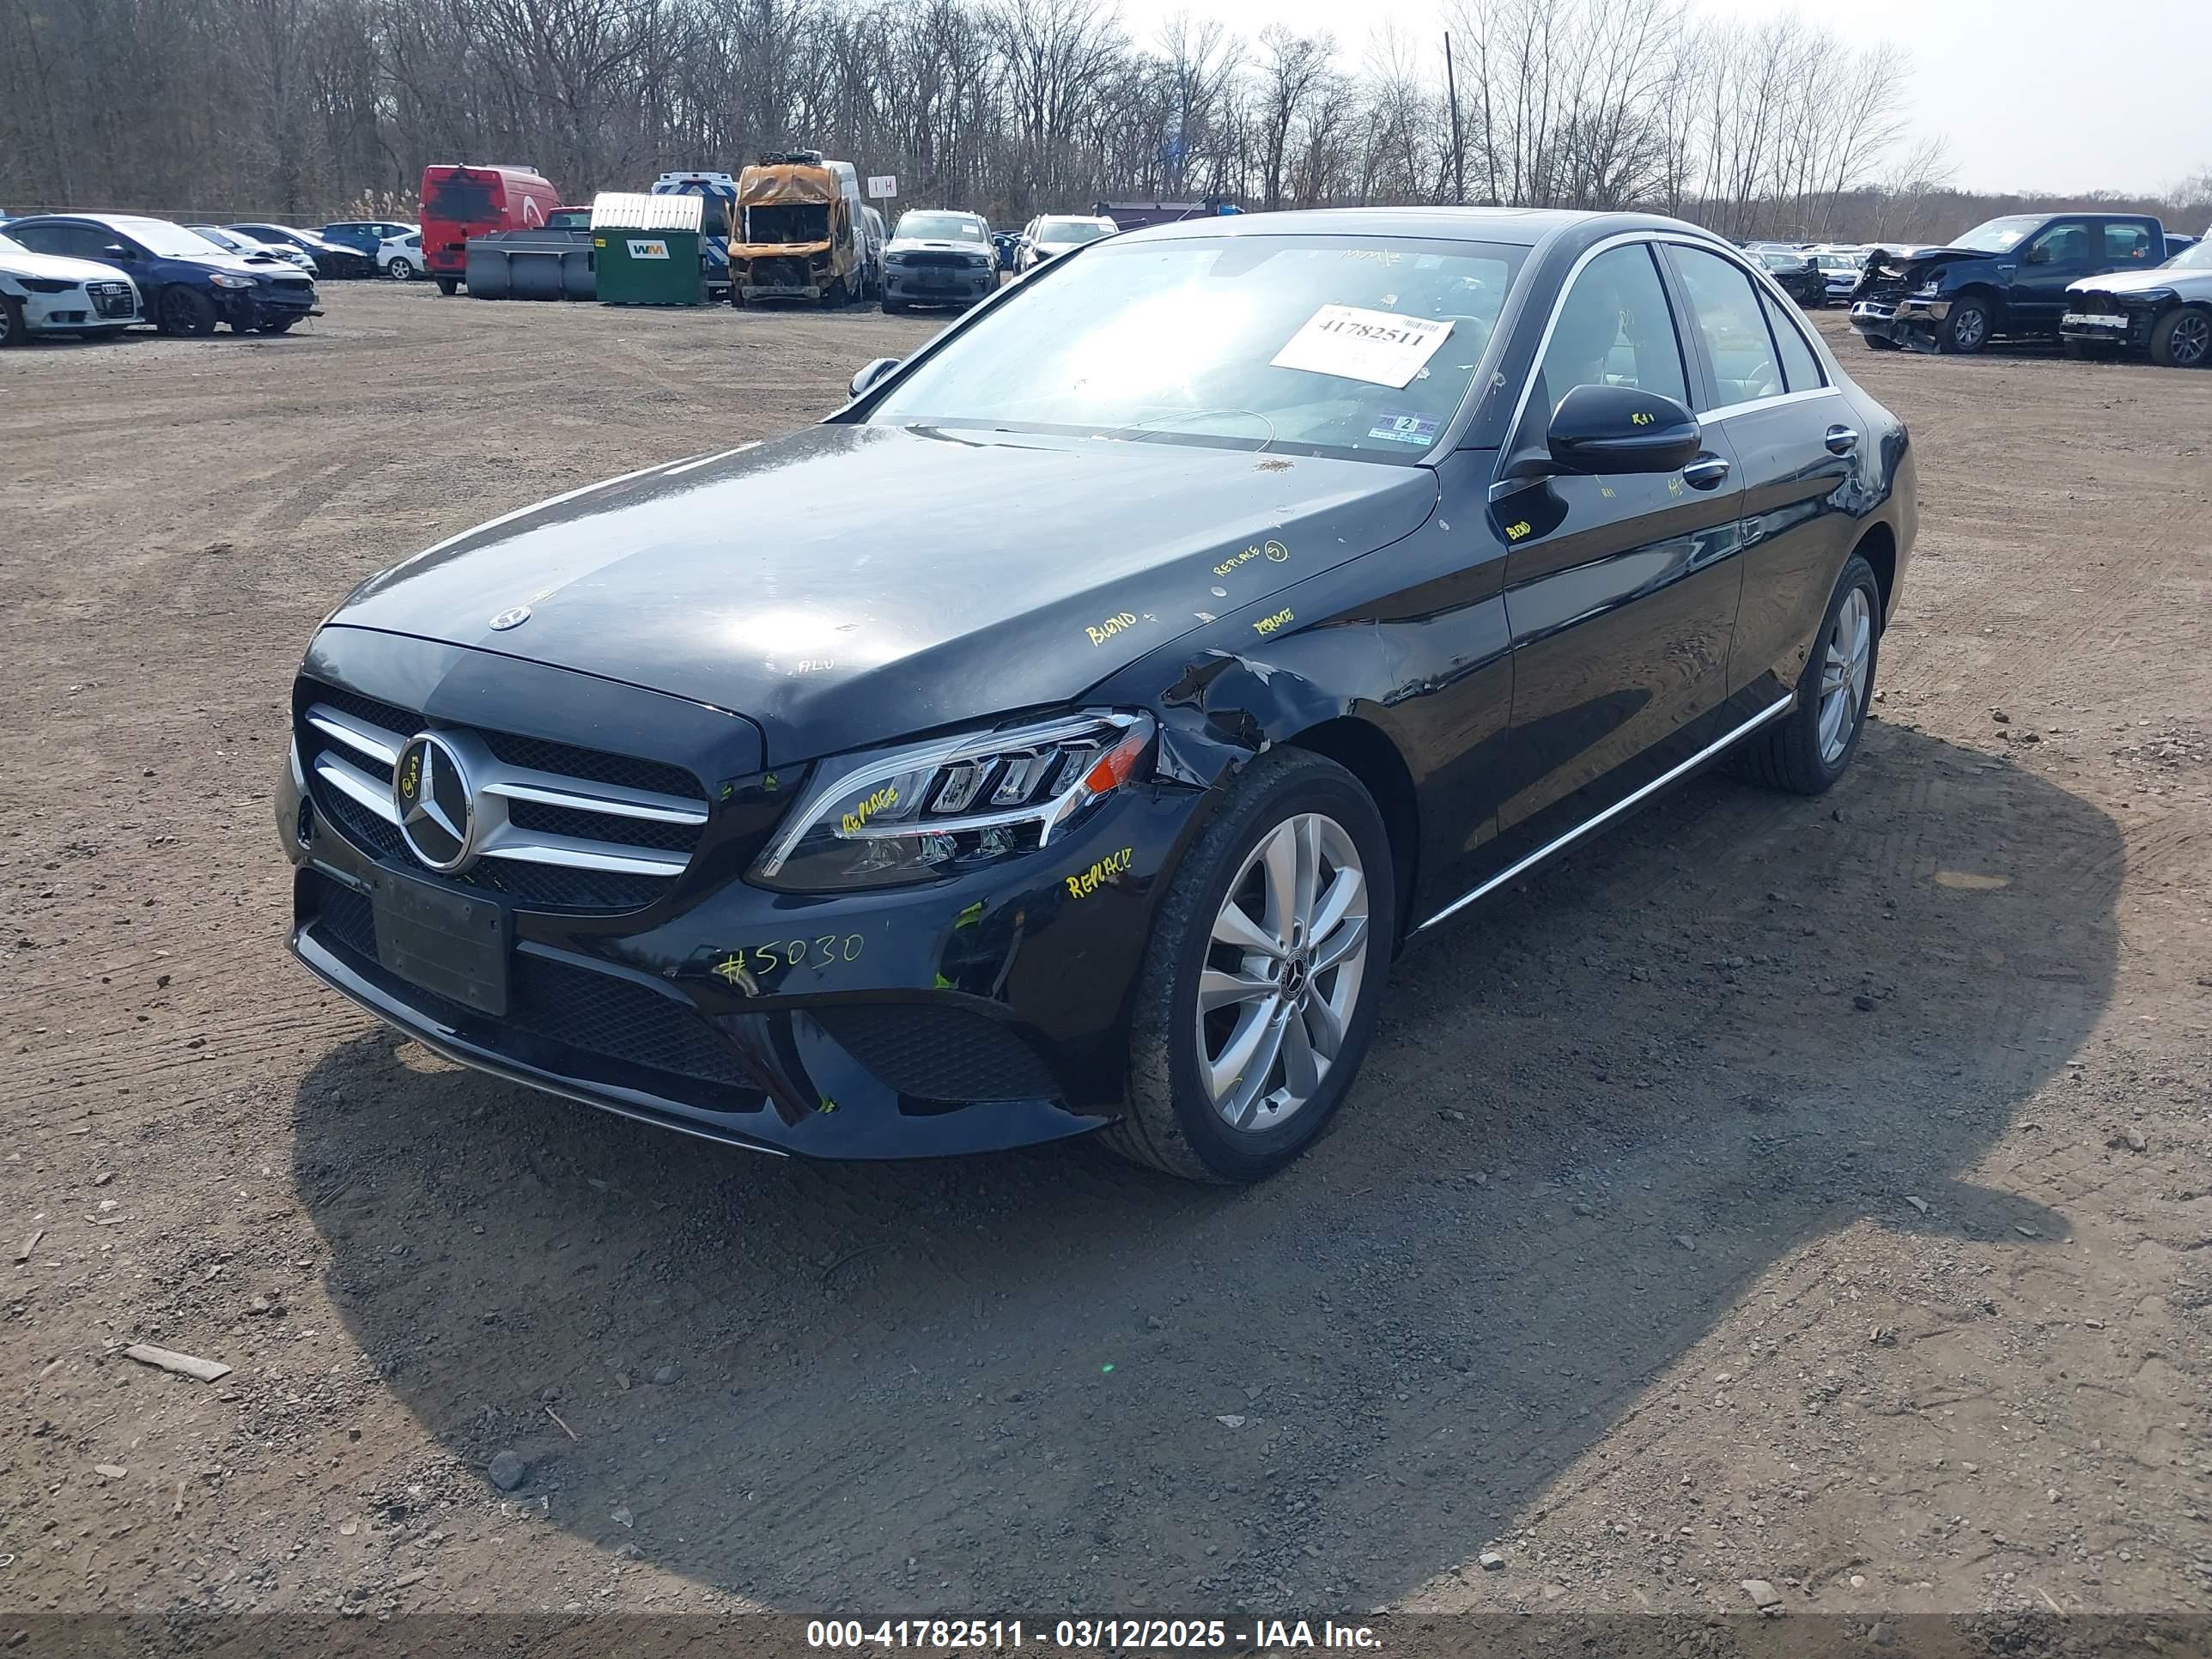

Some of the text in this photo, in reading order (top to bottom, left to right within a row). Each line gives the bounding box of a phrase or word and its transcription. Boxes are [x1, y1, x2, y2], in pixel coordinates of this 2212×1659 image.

[885, 180, 892, 191] H
[634, 246, 664, 255] WM
[1319, 319, 1425, 346] 41782511
[1401, 418, 1413, 429] 2
[1212, 544, 1260, 578] REPLACE
[718, 933, 865, 985] #5030
